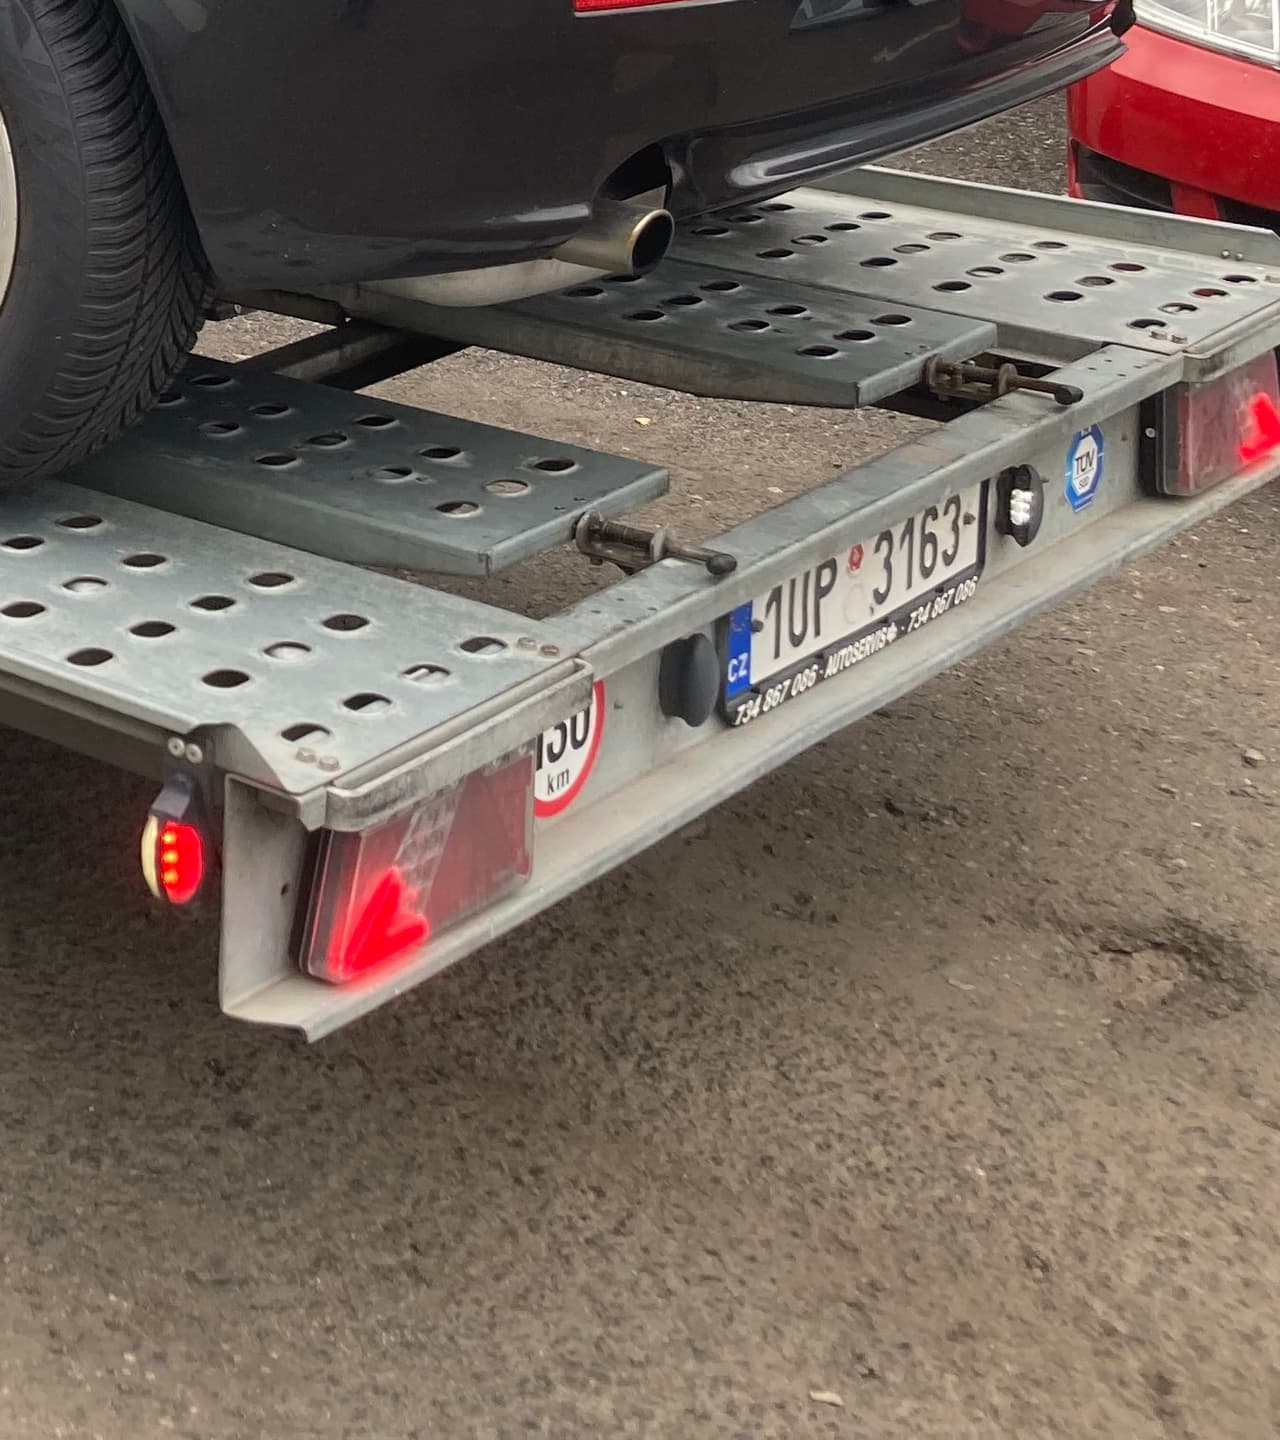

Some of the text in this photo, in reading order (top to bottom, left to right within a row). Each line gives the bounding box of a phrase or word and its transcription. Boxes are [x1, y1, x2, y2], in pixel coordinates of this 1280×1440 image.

[765, 493, 962, 660] 1UP 3163
[728, 652, 748, 683] CZ
[732, 694, 762, 726] 734
[762, 678, 792, 712] 867
[791, 664, 819, 697] 086
[824, 626, 887, 678] AUTOSERVIS
[907, 601, 932, 633] 734
[931, 588, 956, 618] 867
[954, 575, 978, 605] 086
[547, 768, 570, 796] km
